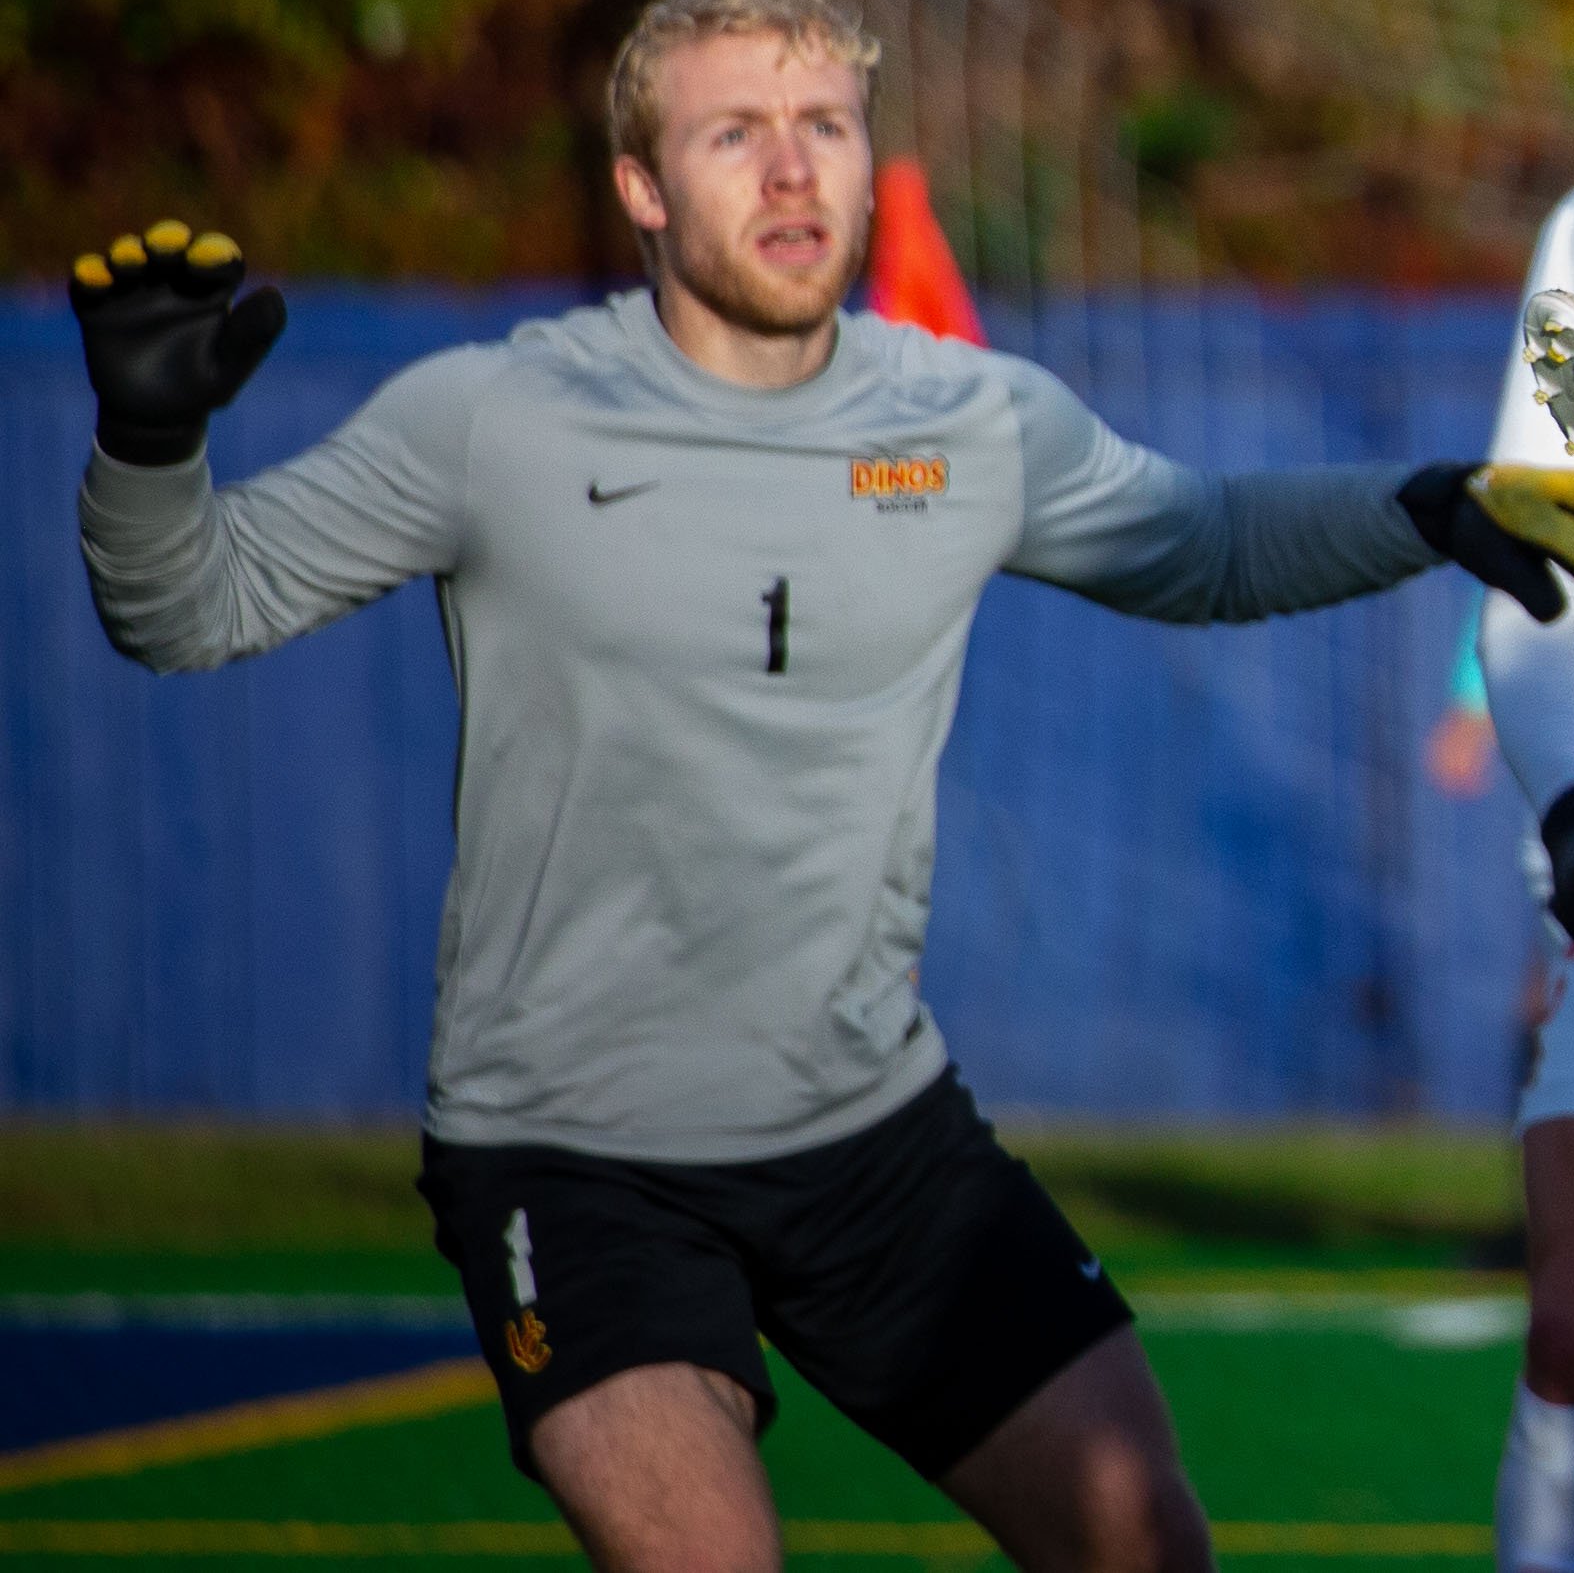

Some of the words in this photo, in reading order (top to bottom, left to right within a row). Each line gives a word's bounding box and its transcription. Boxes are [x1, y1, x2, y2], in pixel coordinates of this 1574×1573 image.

[851, 456, 948, 498] DINOS
[761, 576, 789, 676] 1
[504, 1207, 538, 1307] 1
